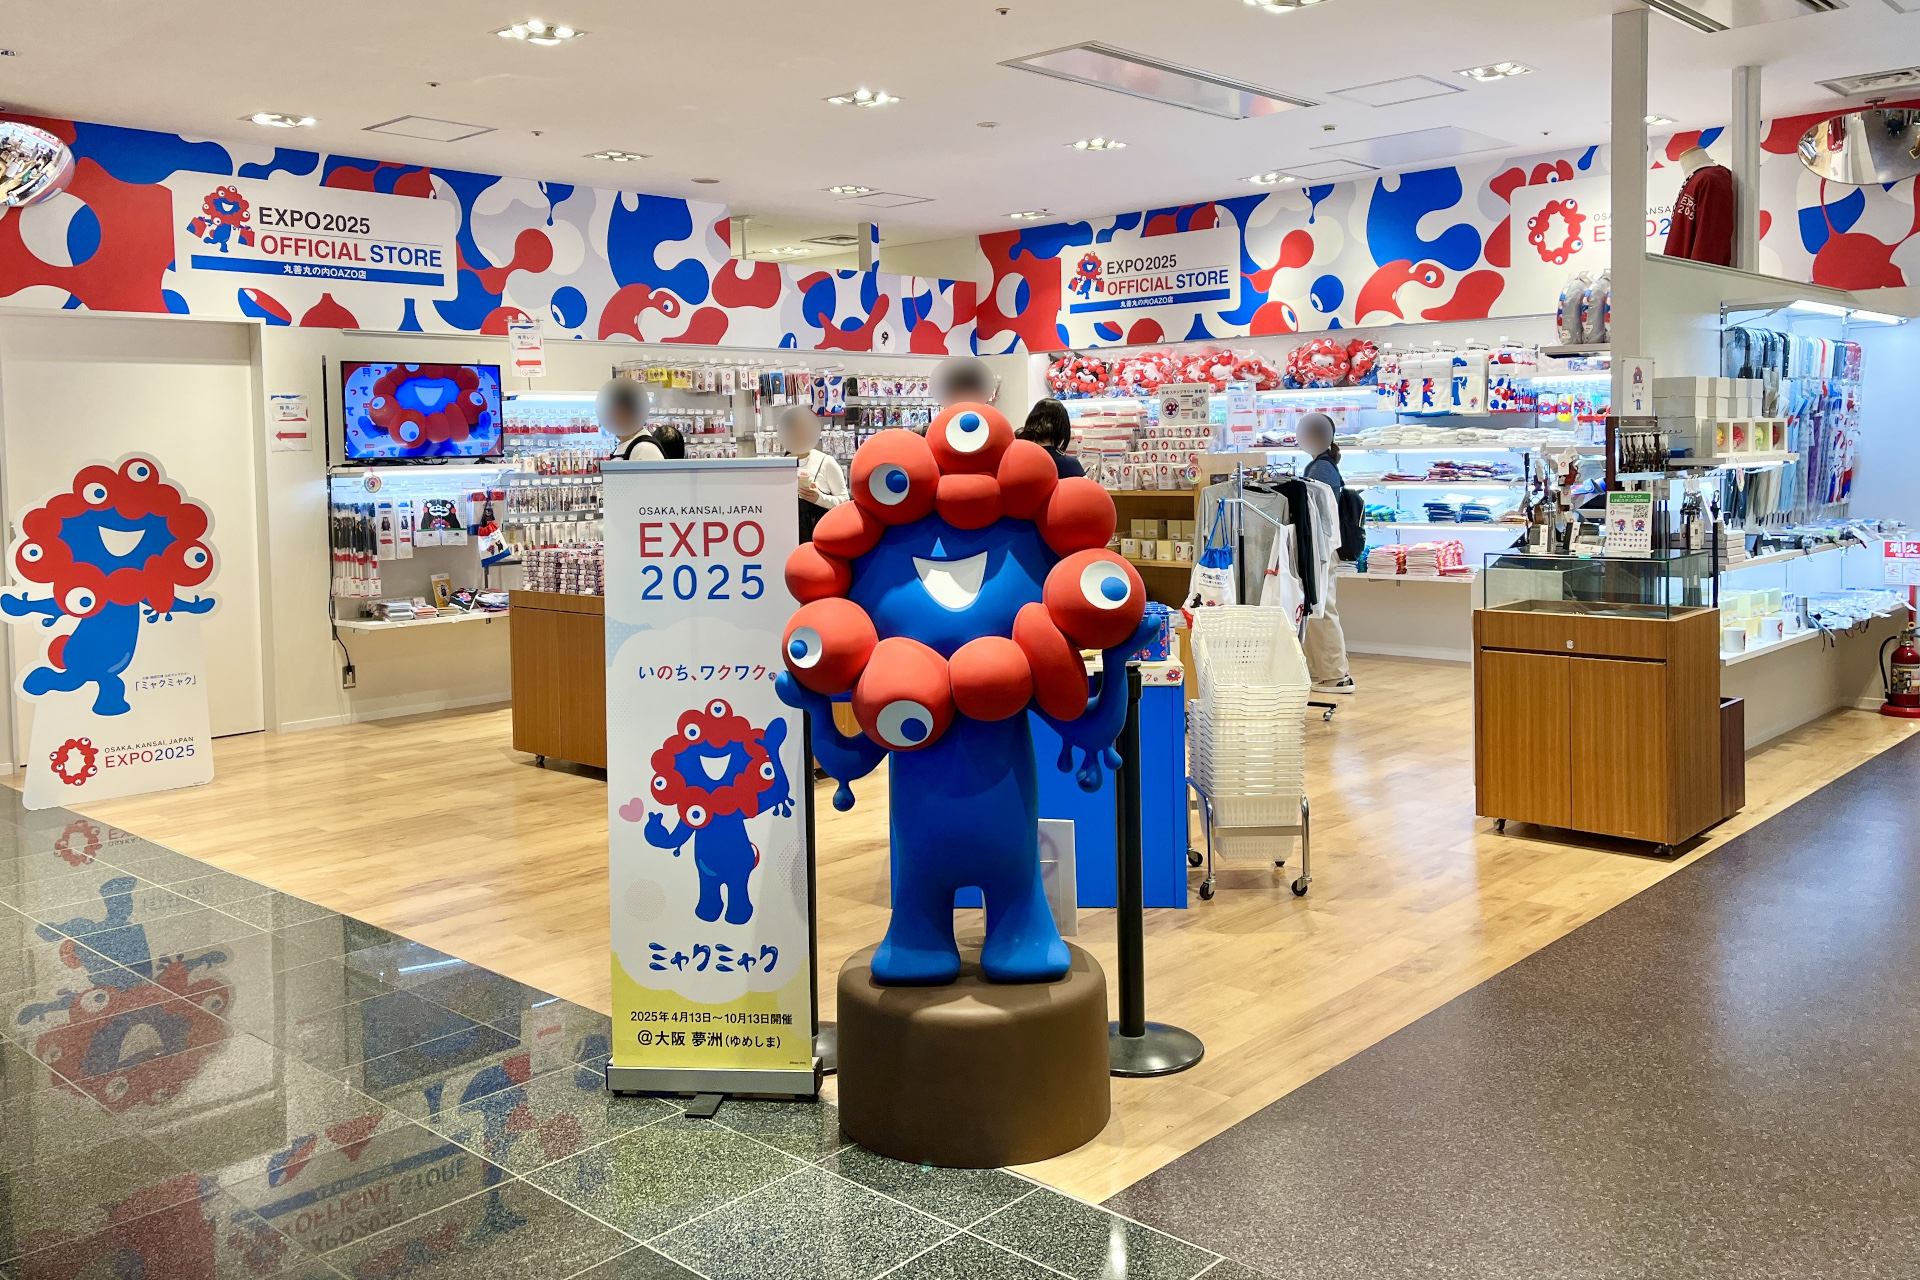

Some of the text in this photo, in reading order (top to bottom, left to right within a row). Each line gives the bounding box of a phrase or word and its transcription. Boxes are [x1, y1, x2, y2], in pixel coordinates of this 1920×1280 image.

[258, 206, 371, 235] EXPO2025
[260, 234, 443, 268] OFFICIAL STORE
[283, 263, 367, 280] 丸善丸の内OAZO店
[1106, 254, 1177, 275] EXPO2025
[1107, 269, 1229, 296] OFFICIAL STORE
[1119, 295, 1174, 309] 丸善丸の内OAZO店
[638, 505, 763, 516] OSAKA, KANSAI, JAPAN
[639, 520, 765, 558] EXPO
[641, 564, 765, 601] 2025
[135, 674, 197, 691] 「ミャクミャク」
[104, 744, 135, 754] OSAKA,
[168, 736, 194, 746] JAPAN
[105, 744, 195, 769] EXPO2025
[648, 942, 779, 973] ミャクミャク
